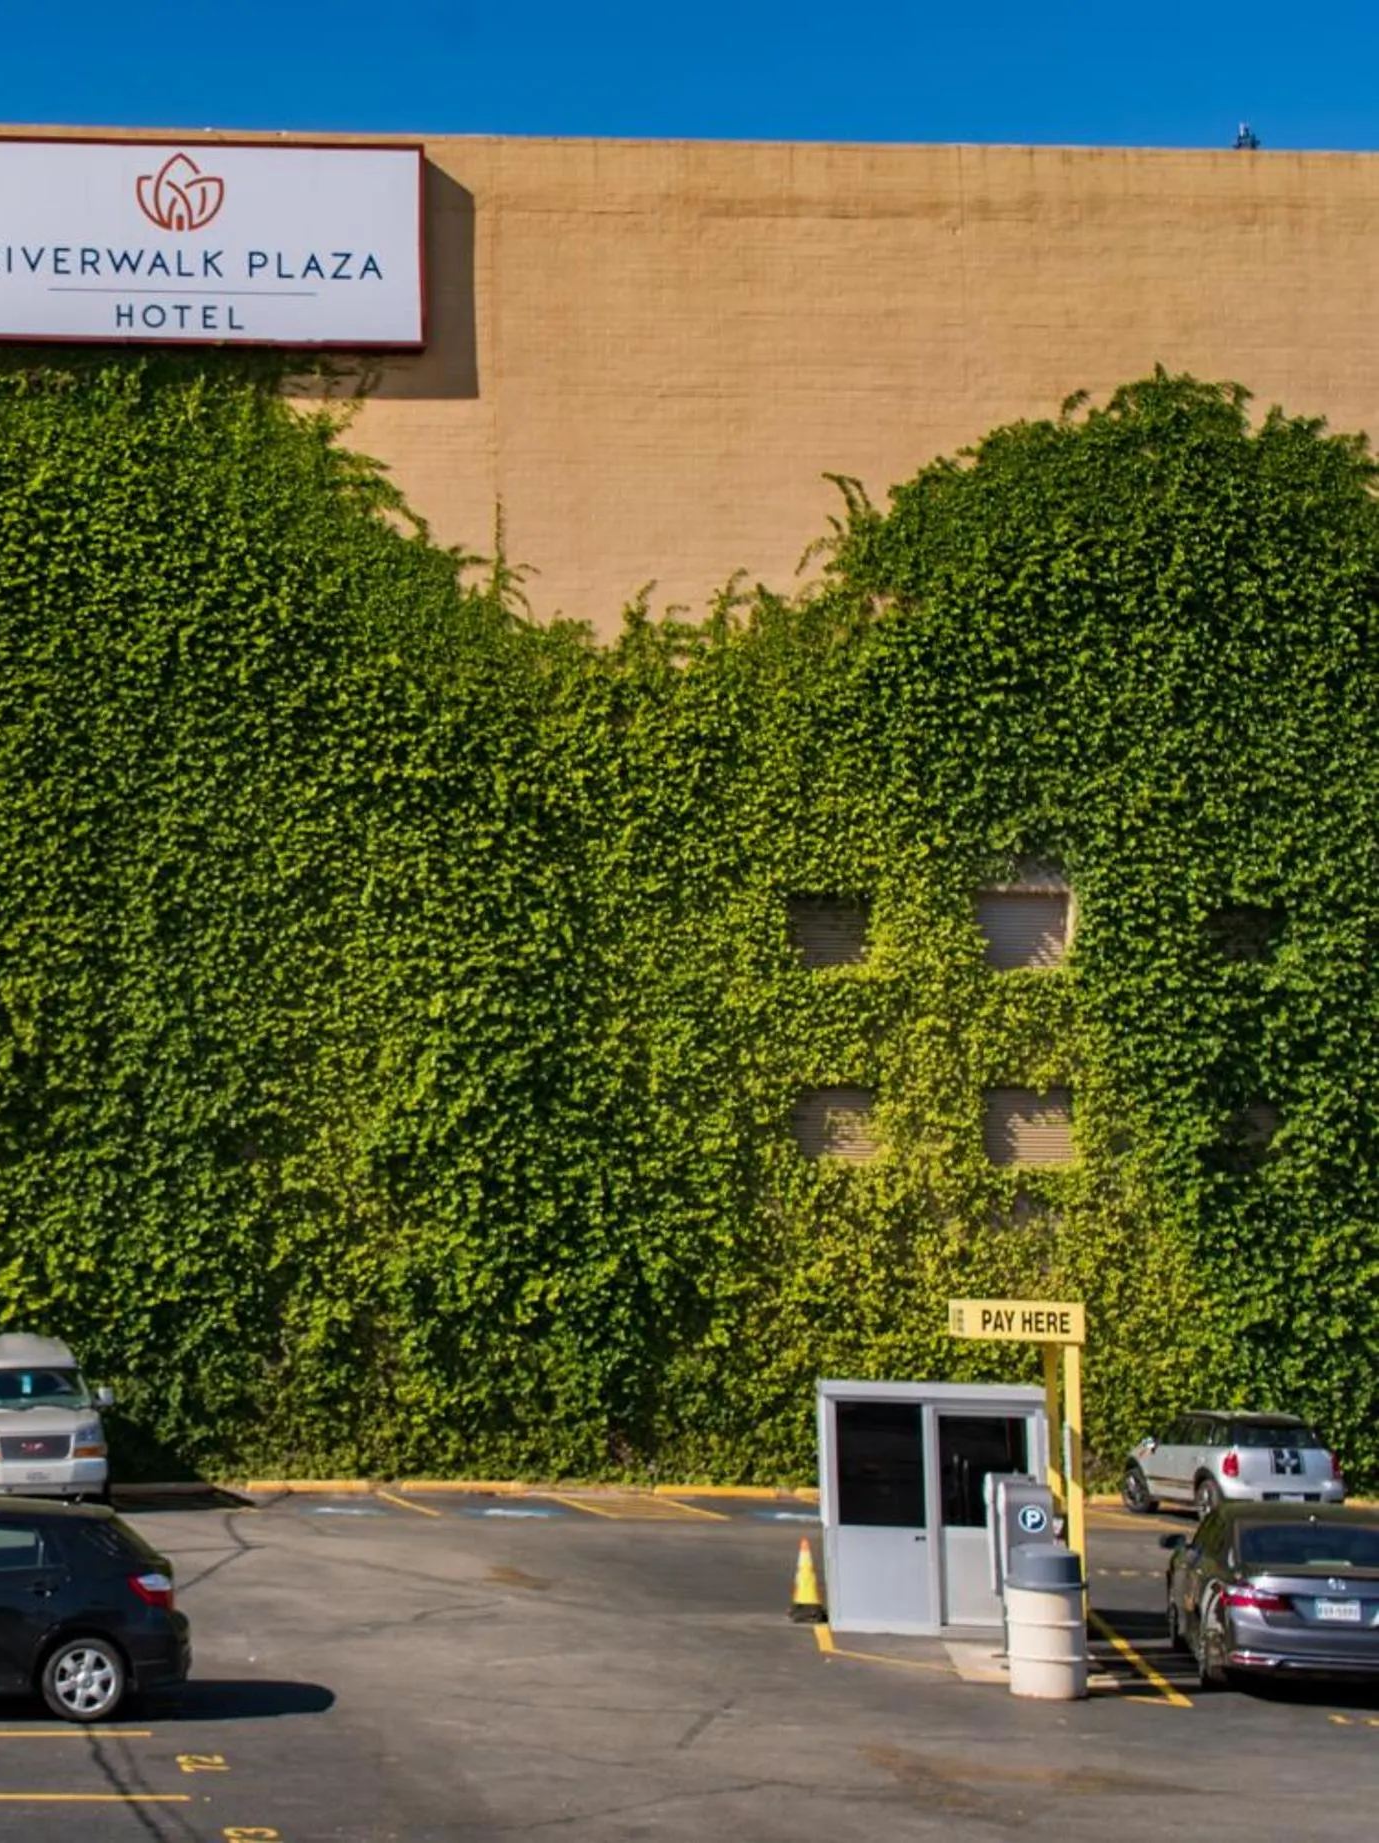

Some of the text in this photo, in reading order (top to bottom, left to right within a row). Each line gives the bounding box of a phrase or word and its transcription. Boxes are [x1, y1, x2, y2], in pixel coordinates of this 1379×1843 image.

[248, 251, 384, 280] PLAZA
[116, 304, 245, 330] HOTEL
[981, 1309, 1015, 1333] PAY
[1021, 1310, 1071, 1334] HERE
[1026, 1509, 1041, 1528] P
